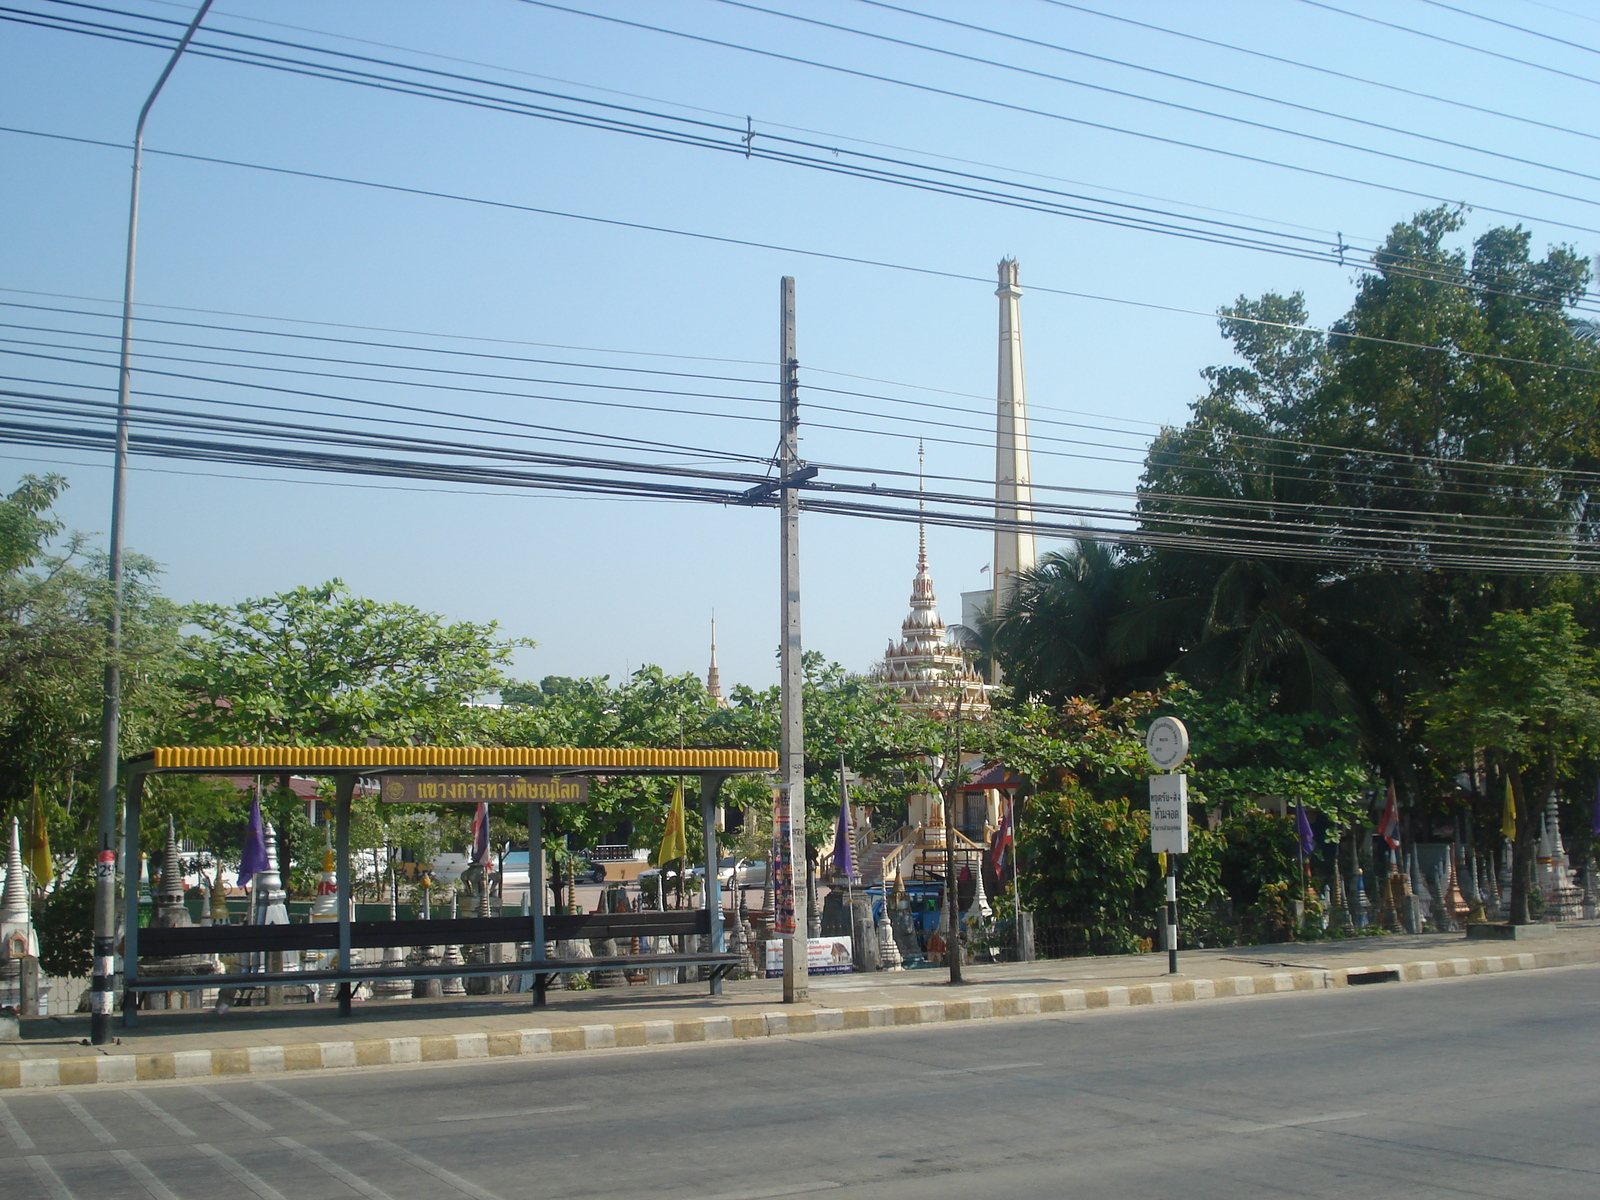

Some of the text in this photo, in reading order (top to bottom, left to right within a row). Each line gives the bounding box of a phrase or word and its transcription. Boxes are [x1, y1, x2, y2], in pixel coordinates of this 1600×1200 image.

[417, 778, 580, 802] แขวงการทางพิษณุโลก
[1154, 806, 1180, 820] ห้ามจอด
